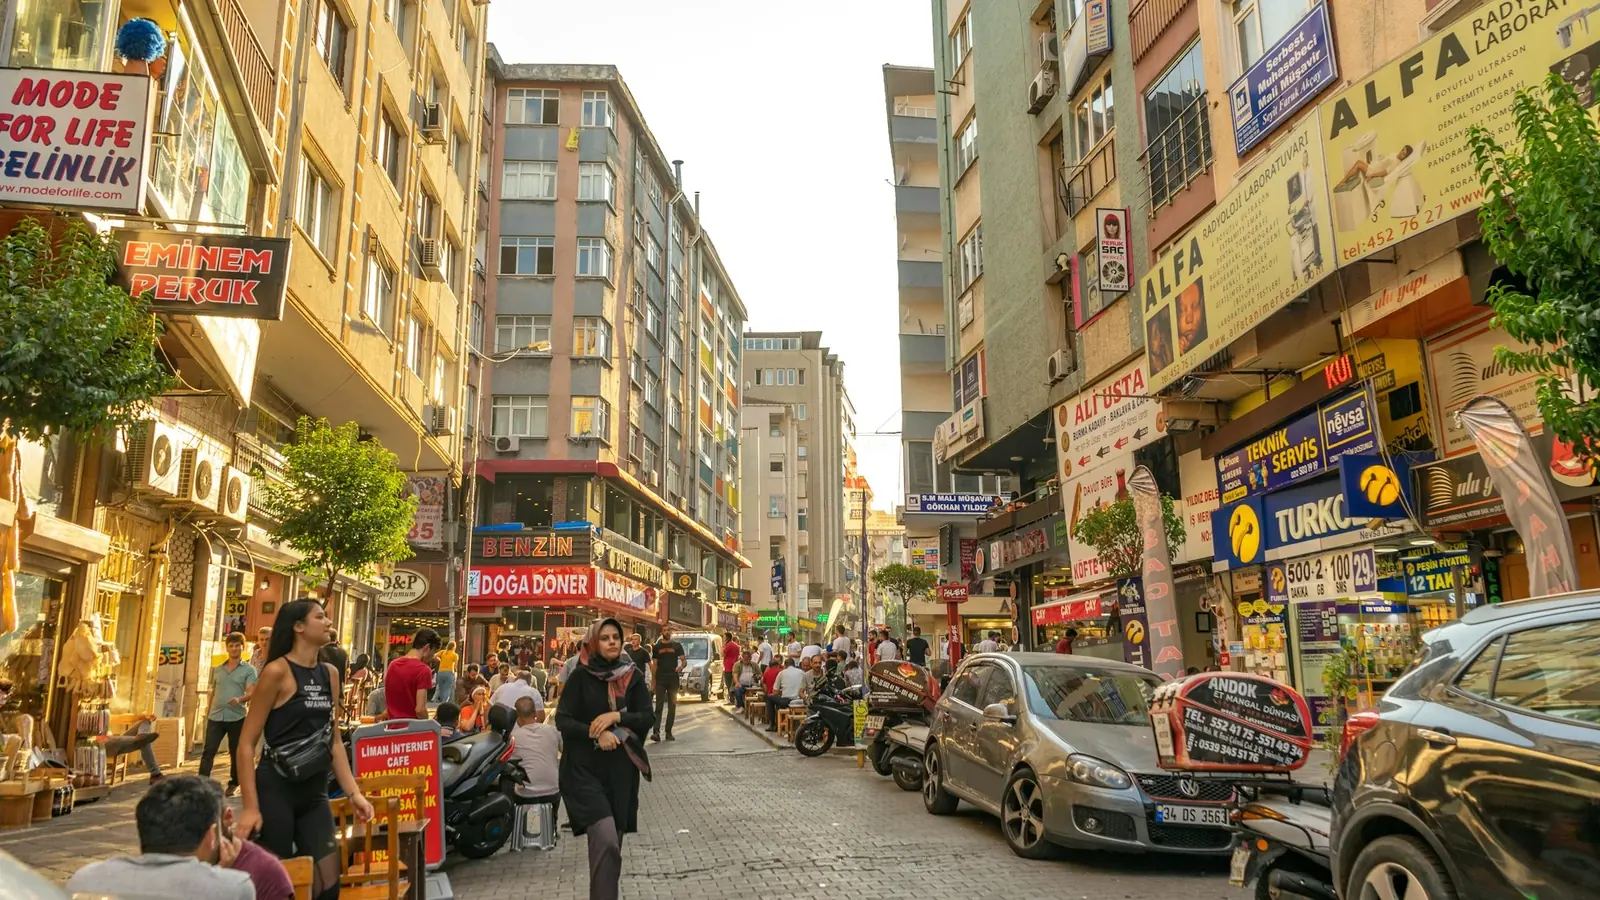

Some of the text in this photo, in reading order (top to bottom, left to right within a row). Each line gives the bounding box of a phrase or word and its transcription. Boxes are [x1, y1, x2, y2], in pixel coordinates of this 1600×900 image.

[1473, 0, 1537, 36] RADY
[1475, 0, 1567, 55] LABORA
[1258, 34, 1318, 95] Muhasebeci
[1265, 30, 1305, 72] Serbest
[1257, 49, 1321, 110] Mali Müşavir
[1329, 32, 1471, 140] ALFA
[1435, 73, 1474, 100] BOYUTLU
[1477, 45, 1527, 76] ULTRASON
[11, 77, 123, 111] MODE
[1437, 79, 1525, 131] DENTAL TOMOGRAFİ
[1442, 69, 1514, 112] EXTREMITY EMAR
[0, 113, 136, 148] FOR LIFE
[1427, 142, 1473, 168] PANORAM
[1450, 157, 1479, 174] RENKL
[1202, 191, 1243, 241] RADYOLOJİ
[1243, 130, 1310, 203] LABORATUVARI
[1439, 172, 1479, 196] LABORAT
[1343, 227, 1395, 260] tel:452
[1400, 215, 1419, 236] 76
[1424, 204, 1444, 223] 27
[123, 239, 273, 275] EMİNEM
[1102, 246, 1125, 256] SAÇ
[1144, 235, 1204, 313] ALFA
[130, 274, 260, 306] PERUK
[1374, 288, 1393, 310] ulu
[1074, 367, 1144, 427] ALİ USTA
[1272, 436, 1319, 474] SERVİS
[1456, 472, 1481, 497] ulu
[926, 503, 988, 511] GÖKHAN YILDIZ
[1275, 493, 1352, 543] TURKC
[482, 532, 573, 557] BENZİN
[1360, 529, 1381, 540] Nevsa
[1073, 558, 1099, 580] KÖFTE
[1287, 560, 1311, 583] 500
[1315, 558, 1323, 580] 2
[1330, 553, 1350, 582] 100
[1416, 559, 1438, 572] PEŞİN
[481, 568, 588, 595] DOĞA DÖNER
[1410, 576, 1426, 592] 12
[1035, 598, 1098, 620] ÇAY ÇAY ÇAY
[1208, 676, 1258, 699] ANDOK
[1213, 690, 1261, 711] ET MANGAL
[1185, 707, 1206, 724] TEL:
[1209, 716, 1229, 732] 552
[1228, 723, 1241, 736] 41
[1243, 728, 1255, 741] 75
[1275, 740, 1290, 753] 49
[1290, 746, 1304, 759] 34
[361, 740, 434, 758] LİMAN İNTERNET
[387, 755, 410, 768] CAFE
[1198, 738, 1220, 753] 0539
[1220, 744, 1237, 758] 345
[1237, 748, 1248, 760] 51
[1248, 750, 1260, 763] 76
[1163, 806, 1177, 820] 34
[1182, 808, 1196, 822] DS
